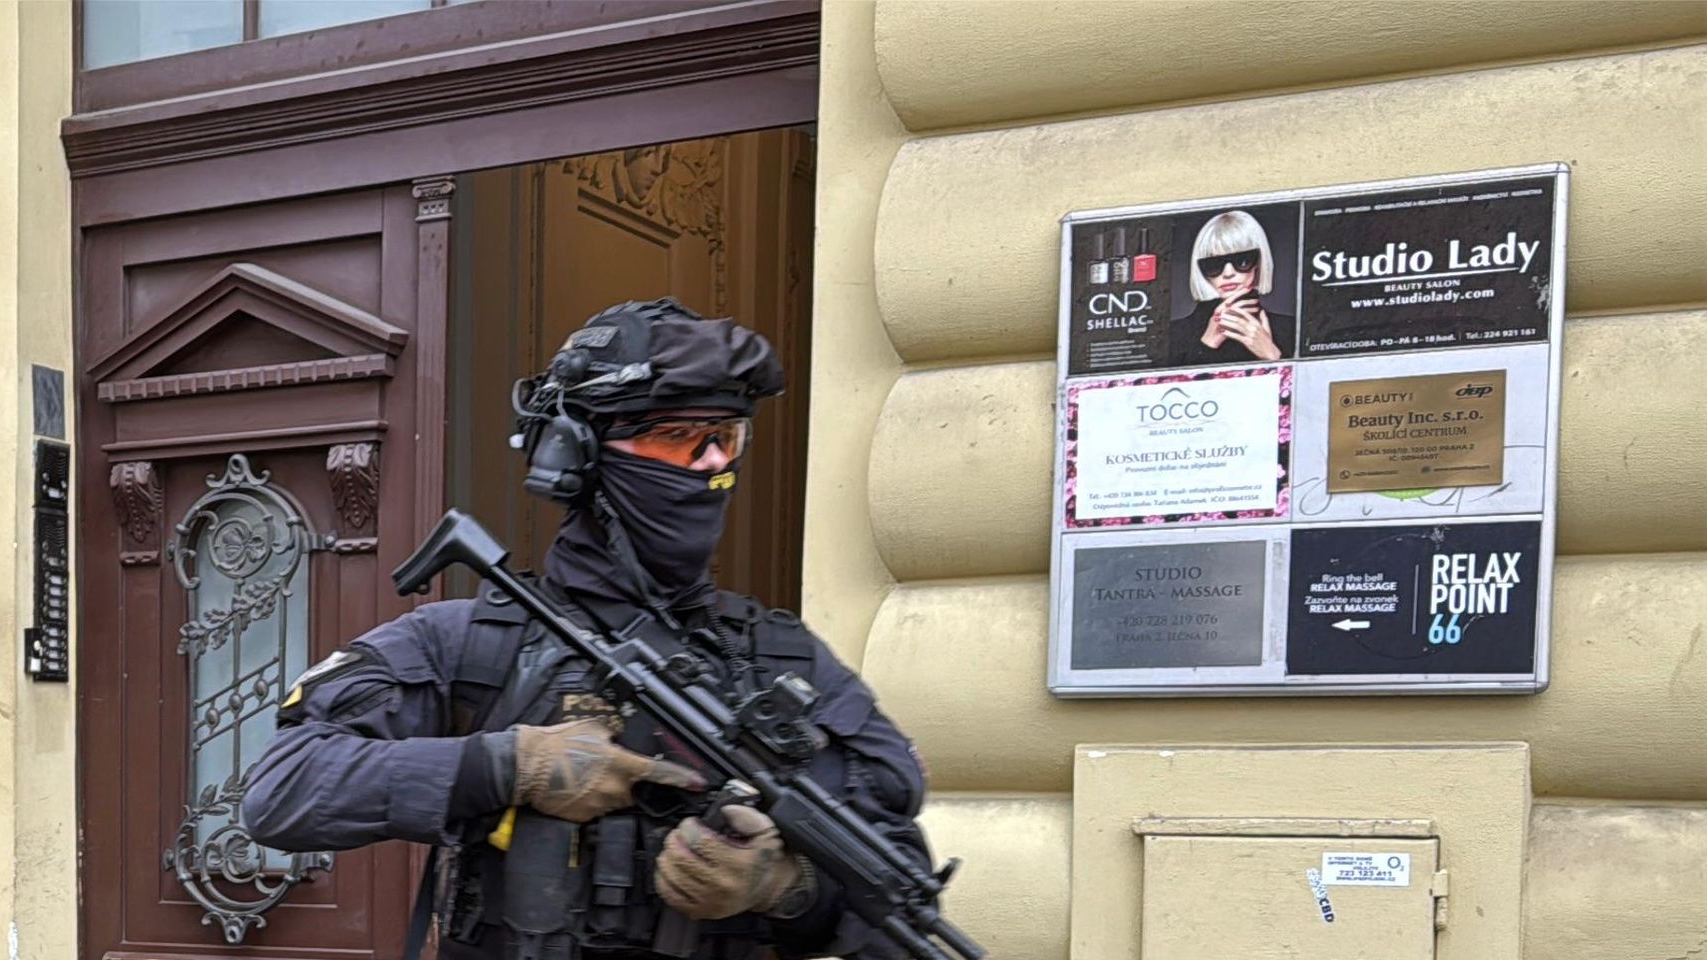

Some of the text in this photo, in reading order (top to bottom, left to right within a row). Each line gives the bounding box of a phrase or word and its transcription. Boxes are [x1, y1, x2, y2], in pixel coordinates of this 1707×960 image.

[1312, 232, 1540, 281] Studio Lady
[1384, 279, 1461, 293] BEAUTY SALON
[1089, 290, 1148, 315] CND
[1350, 288, 1495, 308] www.studiolady.com
[1087, 314, 1148, 331] SHELLAC
[1354, 393, 1407, 405] BEAUTY
[1136, 400, 1219, 422] TOCCO
[1348, 409, 1484, 432] Beauty Inc. s.r.o.
[1409, 426, 1467, 439] CENTRUM
[1105, 445, 1247, 465] KOSMETICKÉ SLUŽBY
[1135, 566, 1202, 581] STUDIO
[1432, 552, 1521, 584] RELAX
[1322, 572, 1384, 584] Ring the bell
[1095, 587, 1155, 601] TANTRA
[1171, 585, 1243, 598] MASSAGE
[1310, 581, 1397, 592] RELAX MASSAGE
[1350, 596, 1362, 604] na
[1364, 594, 1399, 604] zvonek
[1430, 583, 1514, 614] POINT
[1309, 603, 1396, 613] RELAX MASSAGE
[1172, 615, 1192, 625] 219
[1196, 614, 1218, 625] 076
[1205, 630, 1218, 641] 10
[1428, 613, 1462, 644] 66
[1319, 898, 1335, 923] CBD
